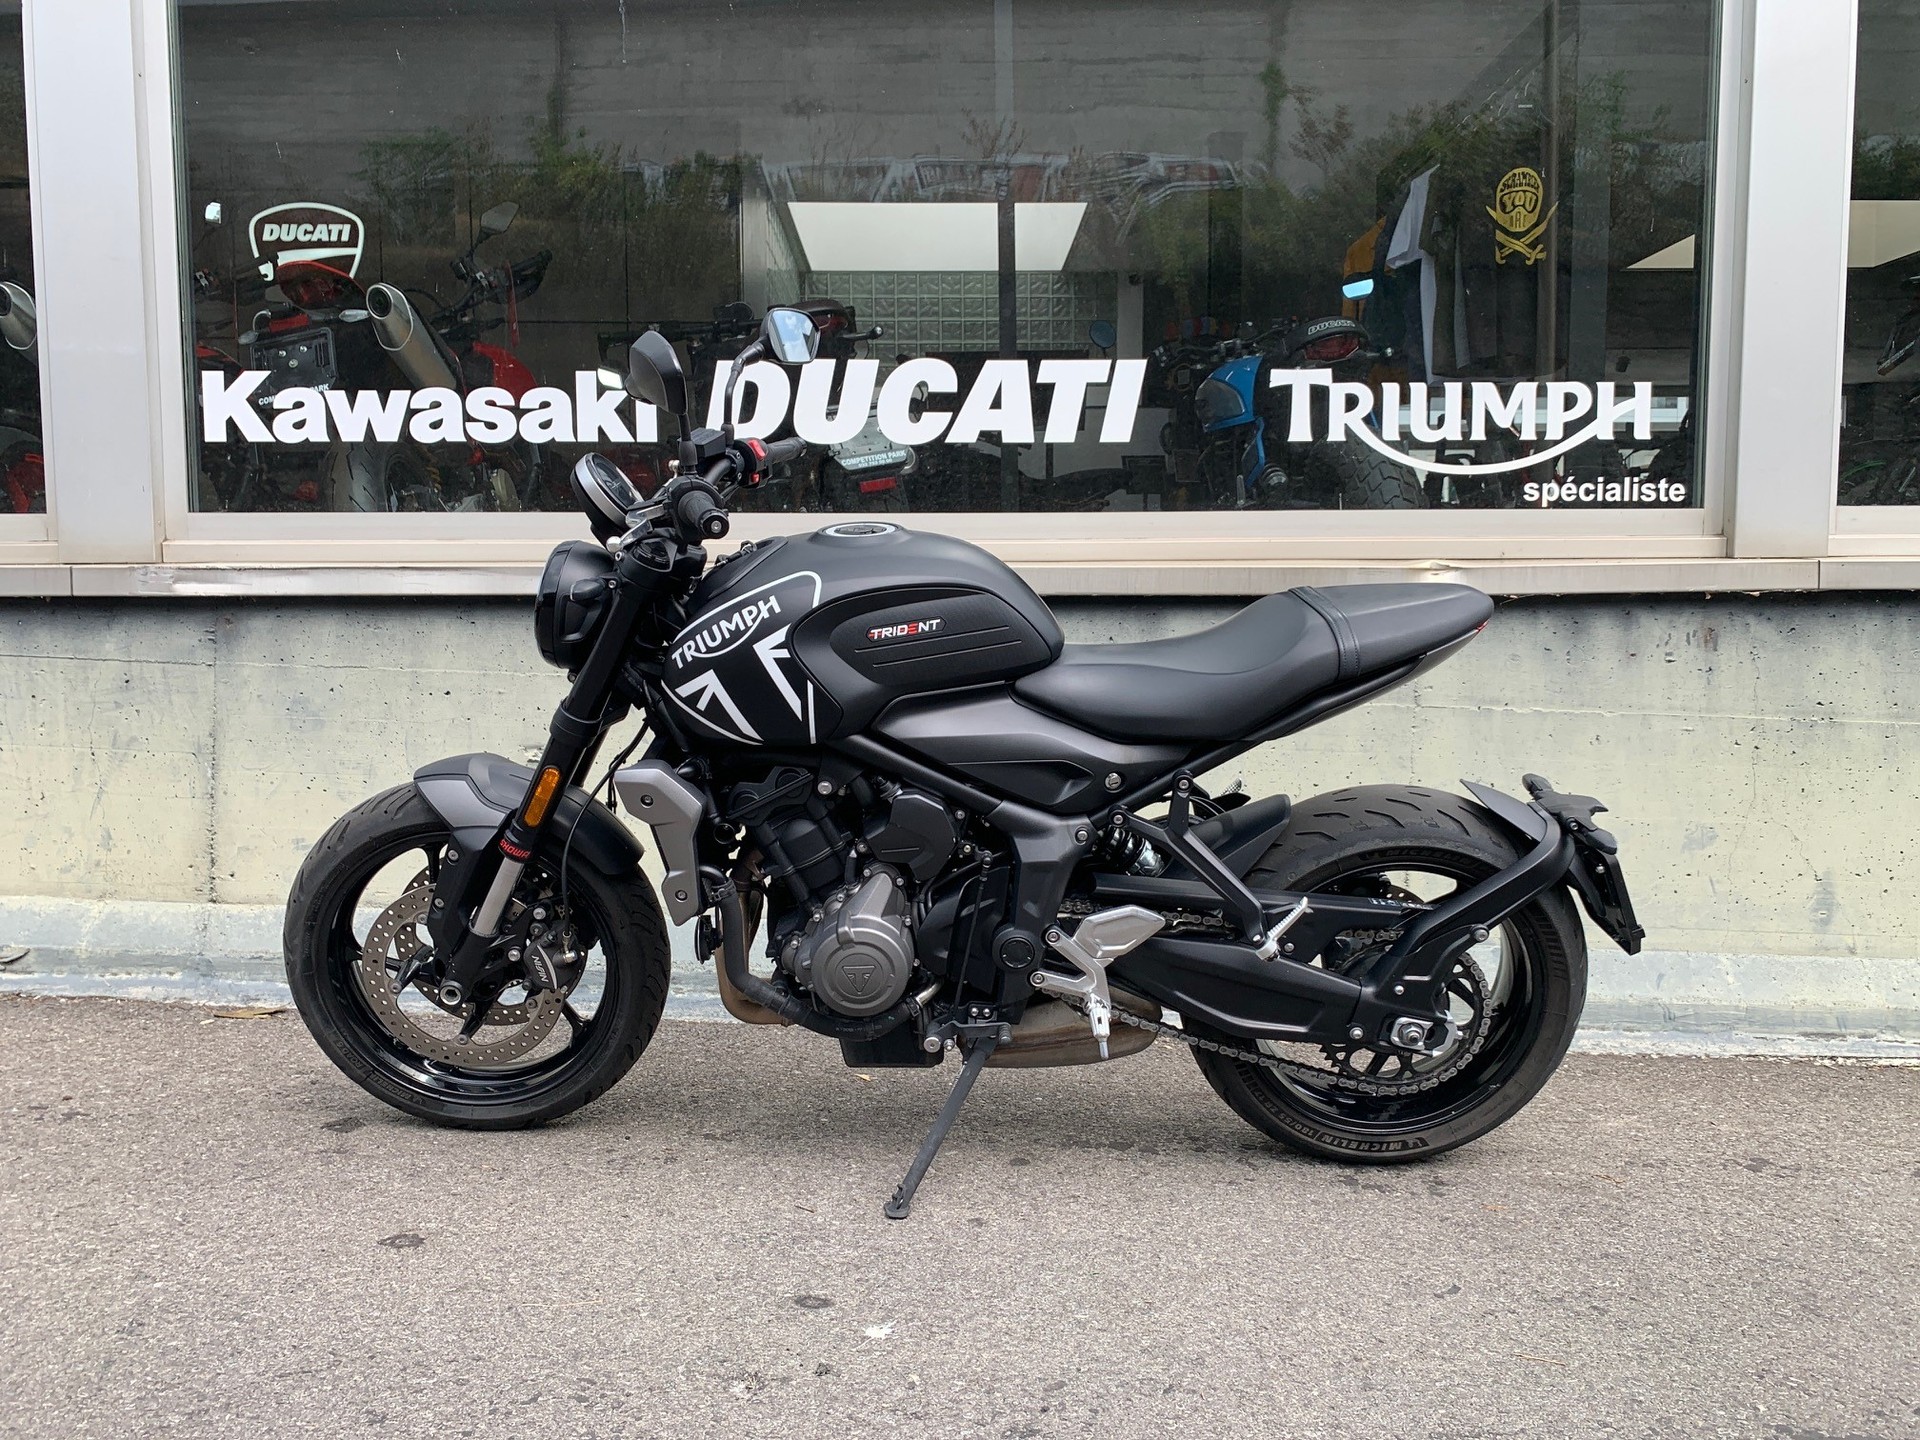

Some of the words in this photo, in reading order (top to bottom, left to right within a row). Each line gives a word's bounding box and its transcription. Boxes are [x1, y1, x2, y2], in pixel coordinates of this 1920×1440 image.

[1502, 191, 1536, 213] YOU
[262, 223, 351, 243] DUCATI
[201, 370, 658, 443] Kawasaki
[706, 357, 1148, 446] DUCATI
[1269, 368, 1653, 475] TRIUMPH
[842, 454, 887, 466] COMPETITION
[888, 450, 905, 459] PARK
[1523, 475, 1687, 508] spécialiste
[671, 594, 781, 669] TRIUMPH
[868, 617, 942, 641] TRIDENT
[499, 838, 531, 859] SHOWA
[1278, 1111, 1314, 1138] 180/55
[1320, 1133, 1403, 1152] MICHELIN
